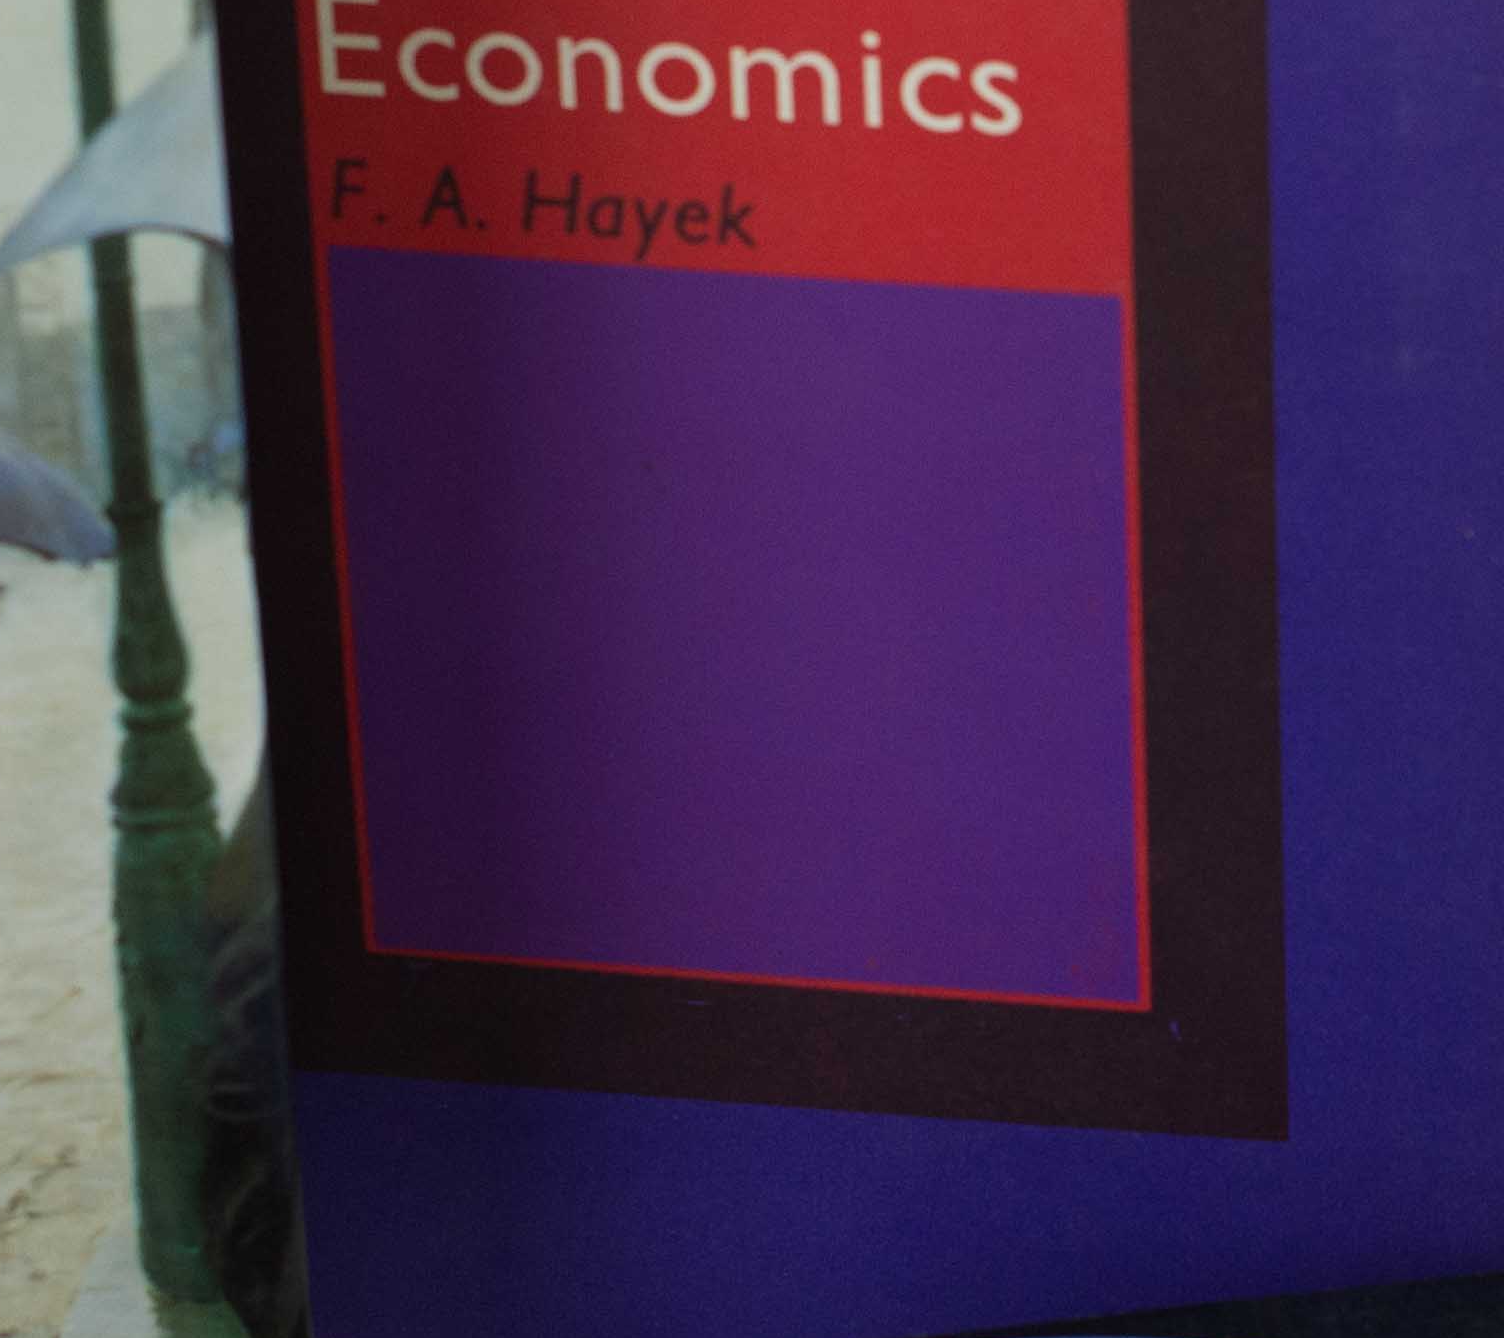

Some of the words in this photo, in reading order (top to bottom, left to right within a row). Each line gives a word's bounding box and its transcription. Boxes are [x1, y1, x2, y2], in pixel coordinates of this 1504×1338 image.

[330, 158, 387, 226] F.
[422, 166, 486, 231] A.
[520, 169, 757, 259] Hayek
